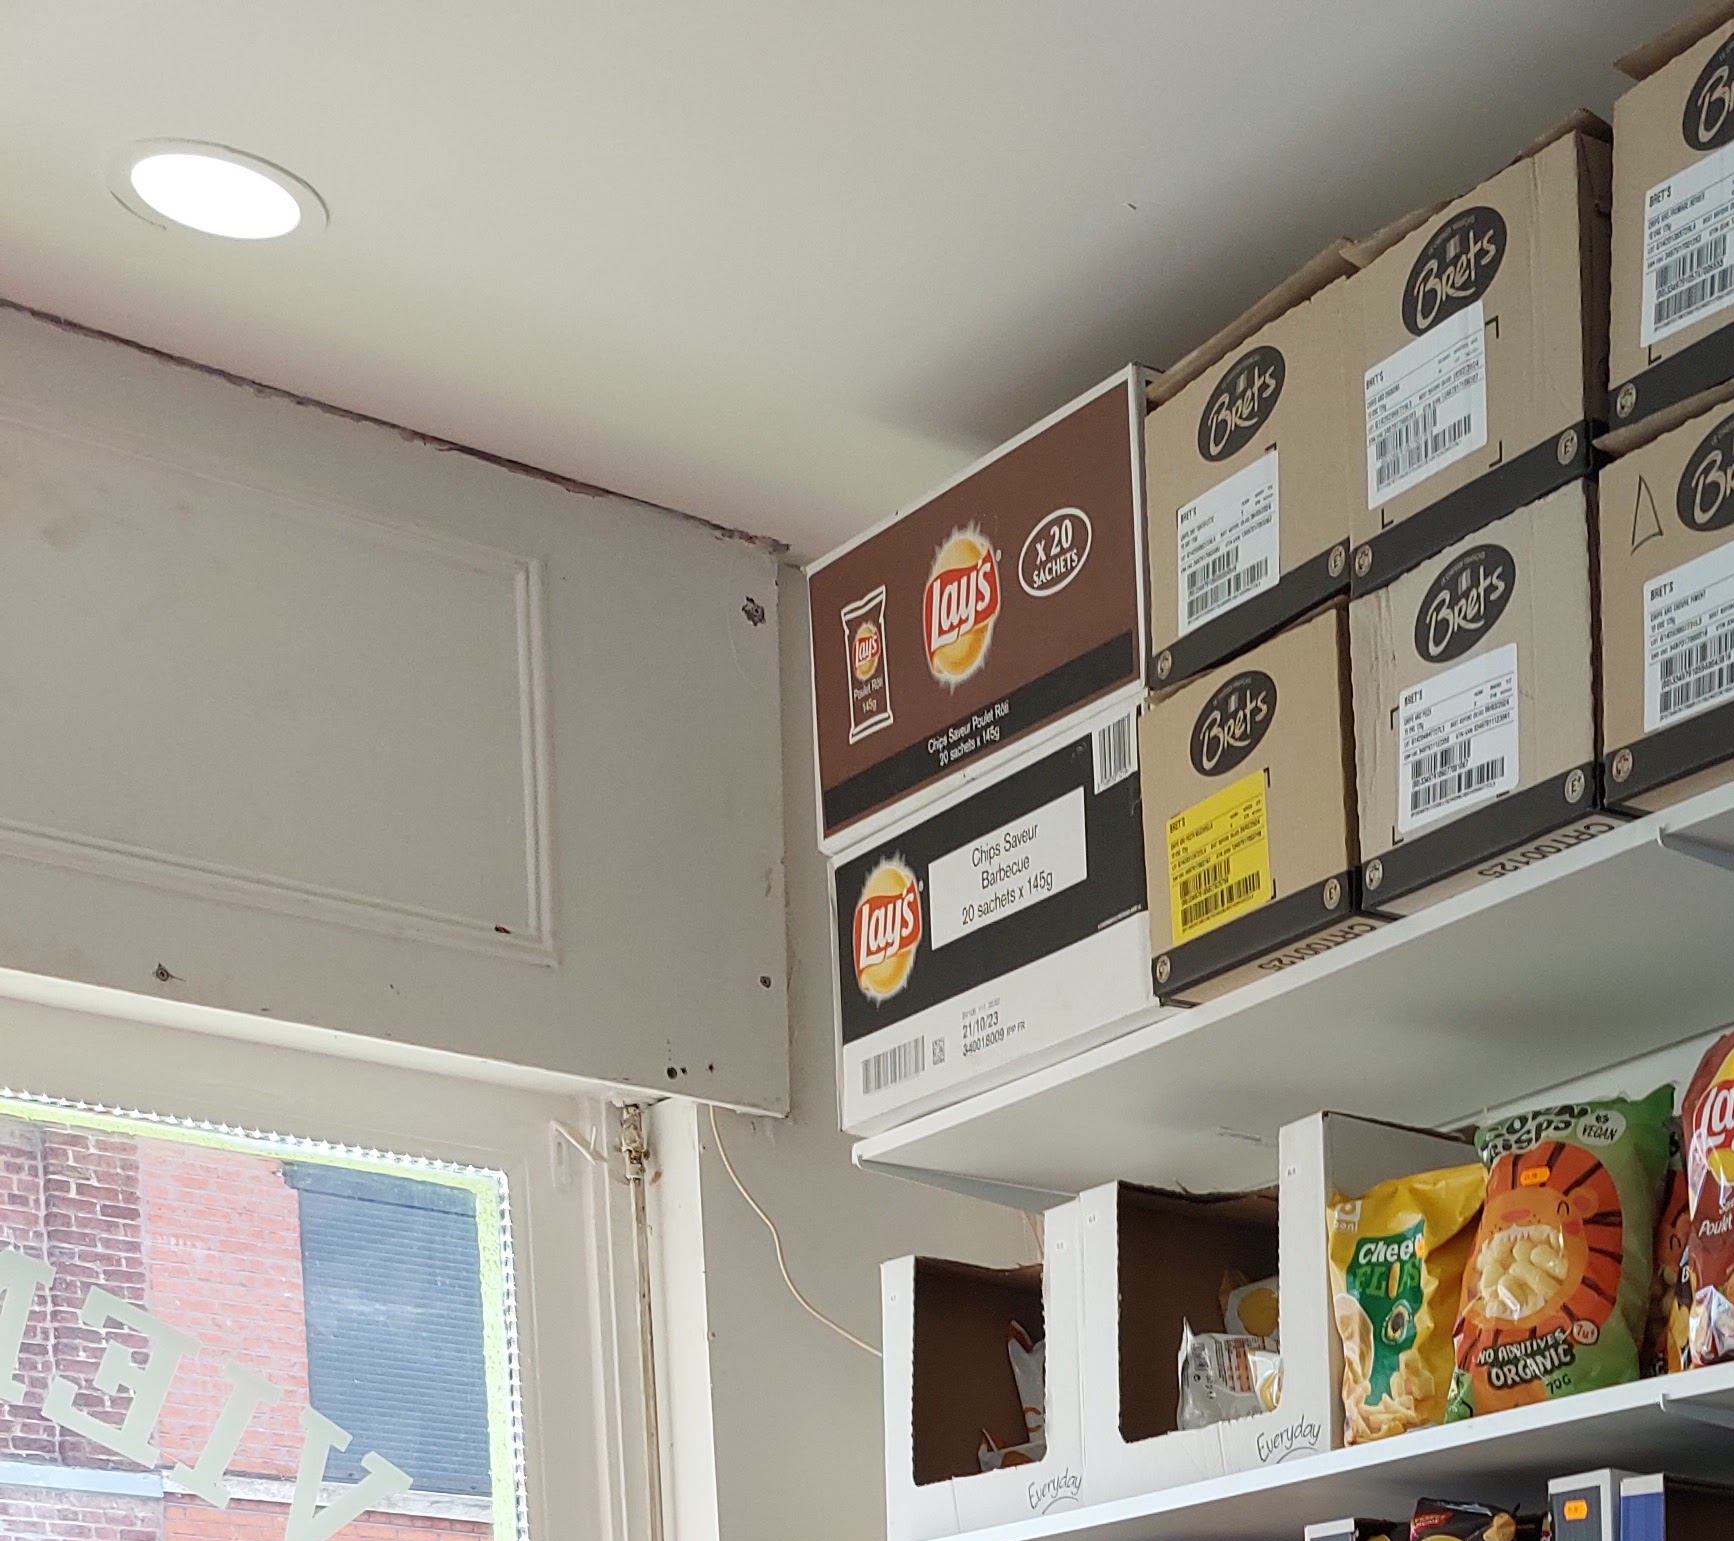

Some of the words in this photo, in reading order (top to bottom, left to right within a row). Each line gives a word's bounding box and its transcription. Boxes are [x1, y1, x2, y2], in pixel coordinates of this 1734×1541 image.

[1414, 228, 1497, 329] Brets
[1208, 358, 1277, 456] Brets
[1050, 522, 1073, 547] 20
[1033, 549, 1078, 588] SACHETS
[931, 557, 991, 650] Lay's
[1427, 563, 1505, 657] Brets
[856, 634, 879, 667] Lay's
[1197, 687, 1269, 771] Brets
[972, 842, 1001, 868] Chips
[1003, 823, 1038, 852] Saveur
[962, 906, 975, 925] 20
[978, 887, 1016, 916] sachets
[1027, 870, 1053, 894] 145g
[982, 856, 1030, 889] Barbecue
[859, 884, 914, 969] Lay's
[1489, 1347, 1572, 1387] ORGANIC
[1257, 1414, 1321, 1464] Everyday
[1028, 1472, 1083, 1510] Everyday
